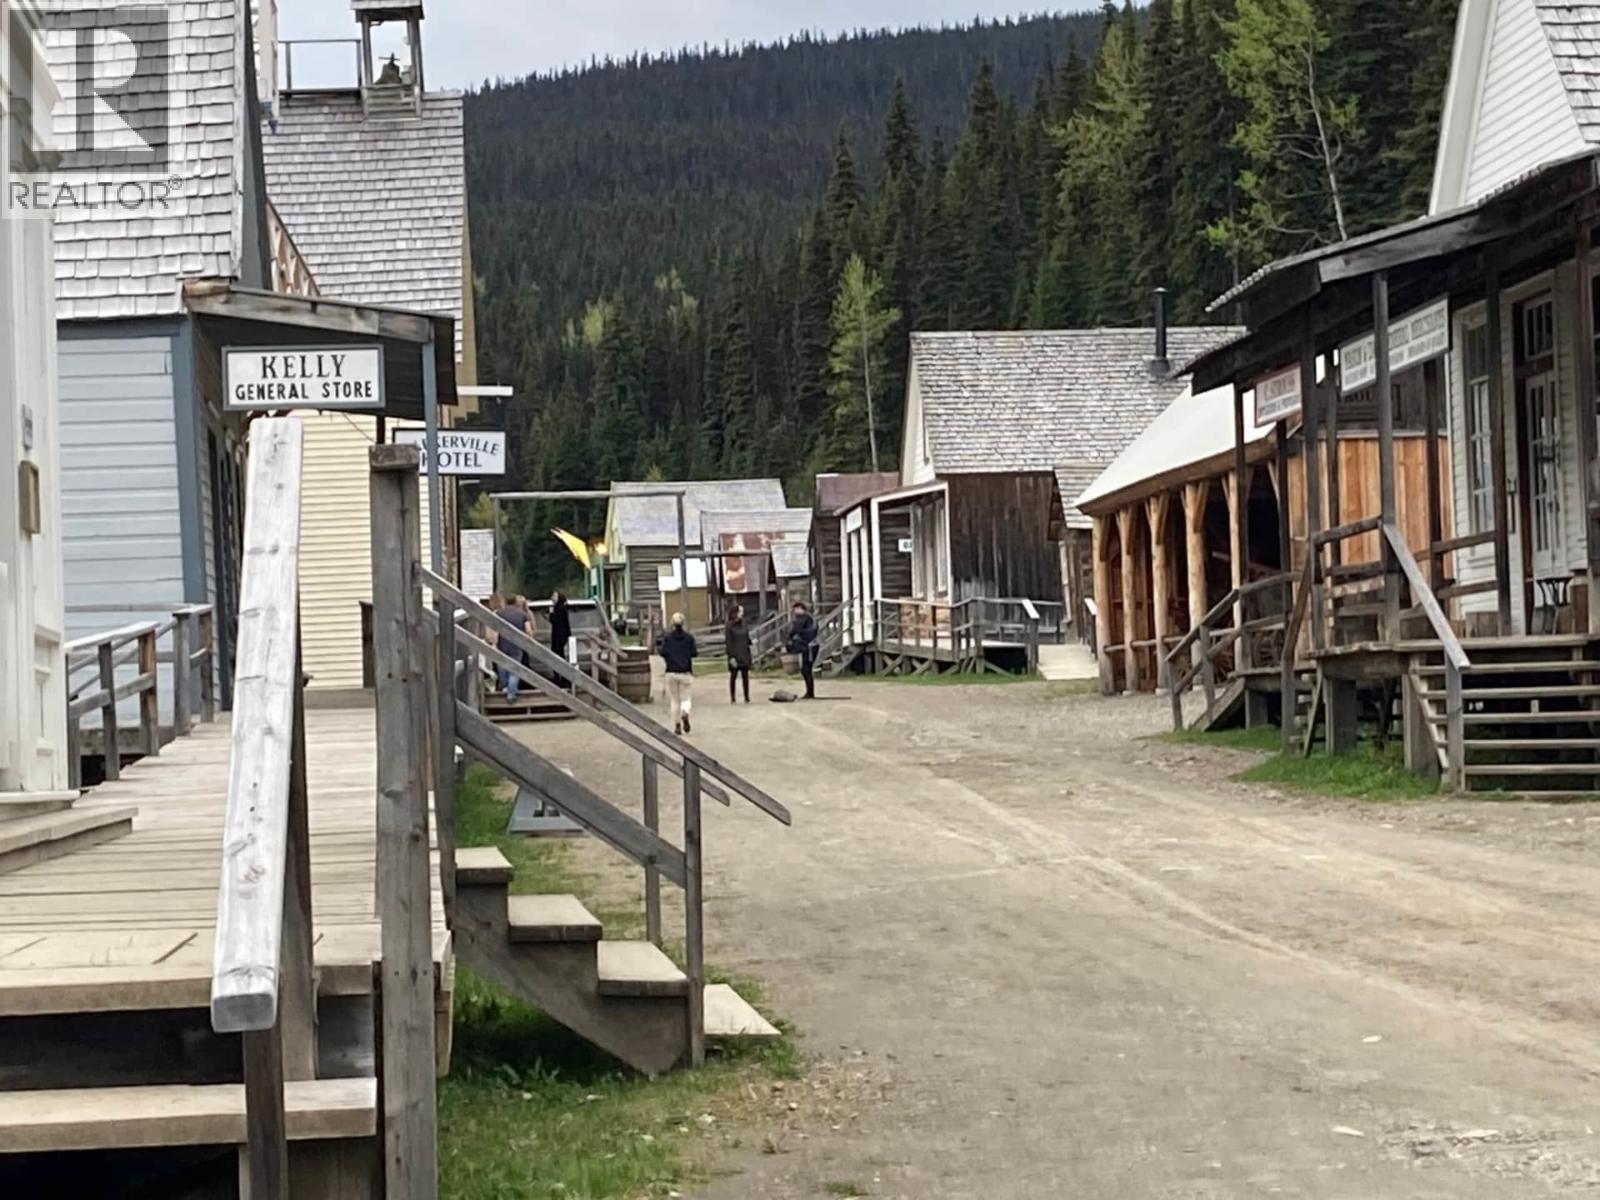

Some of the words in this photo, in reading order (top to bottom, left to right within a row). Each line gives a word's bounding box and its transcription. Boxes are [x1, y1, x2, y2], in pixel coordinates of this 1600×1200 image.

[261, 353, 348, 379] KELLY
[235, 381, 309, 401] GENERAL
[321, 380, 373, 399] STORE
[421, 435, 501, 456] ERVILLE
